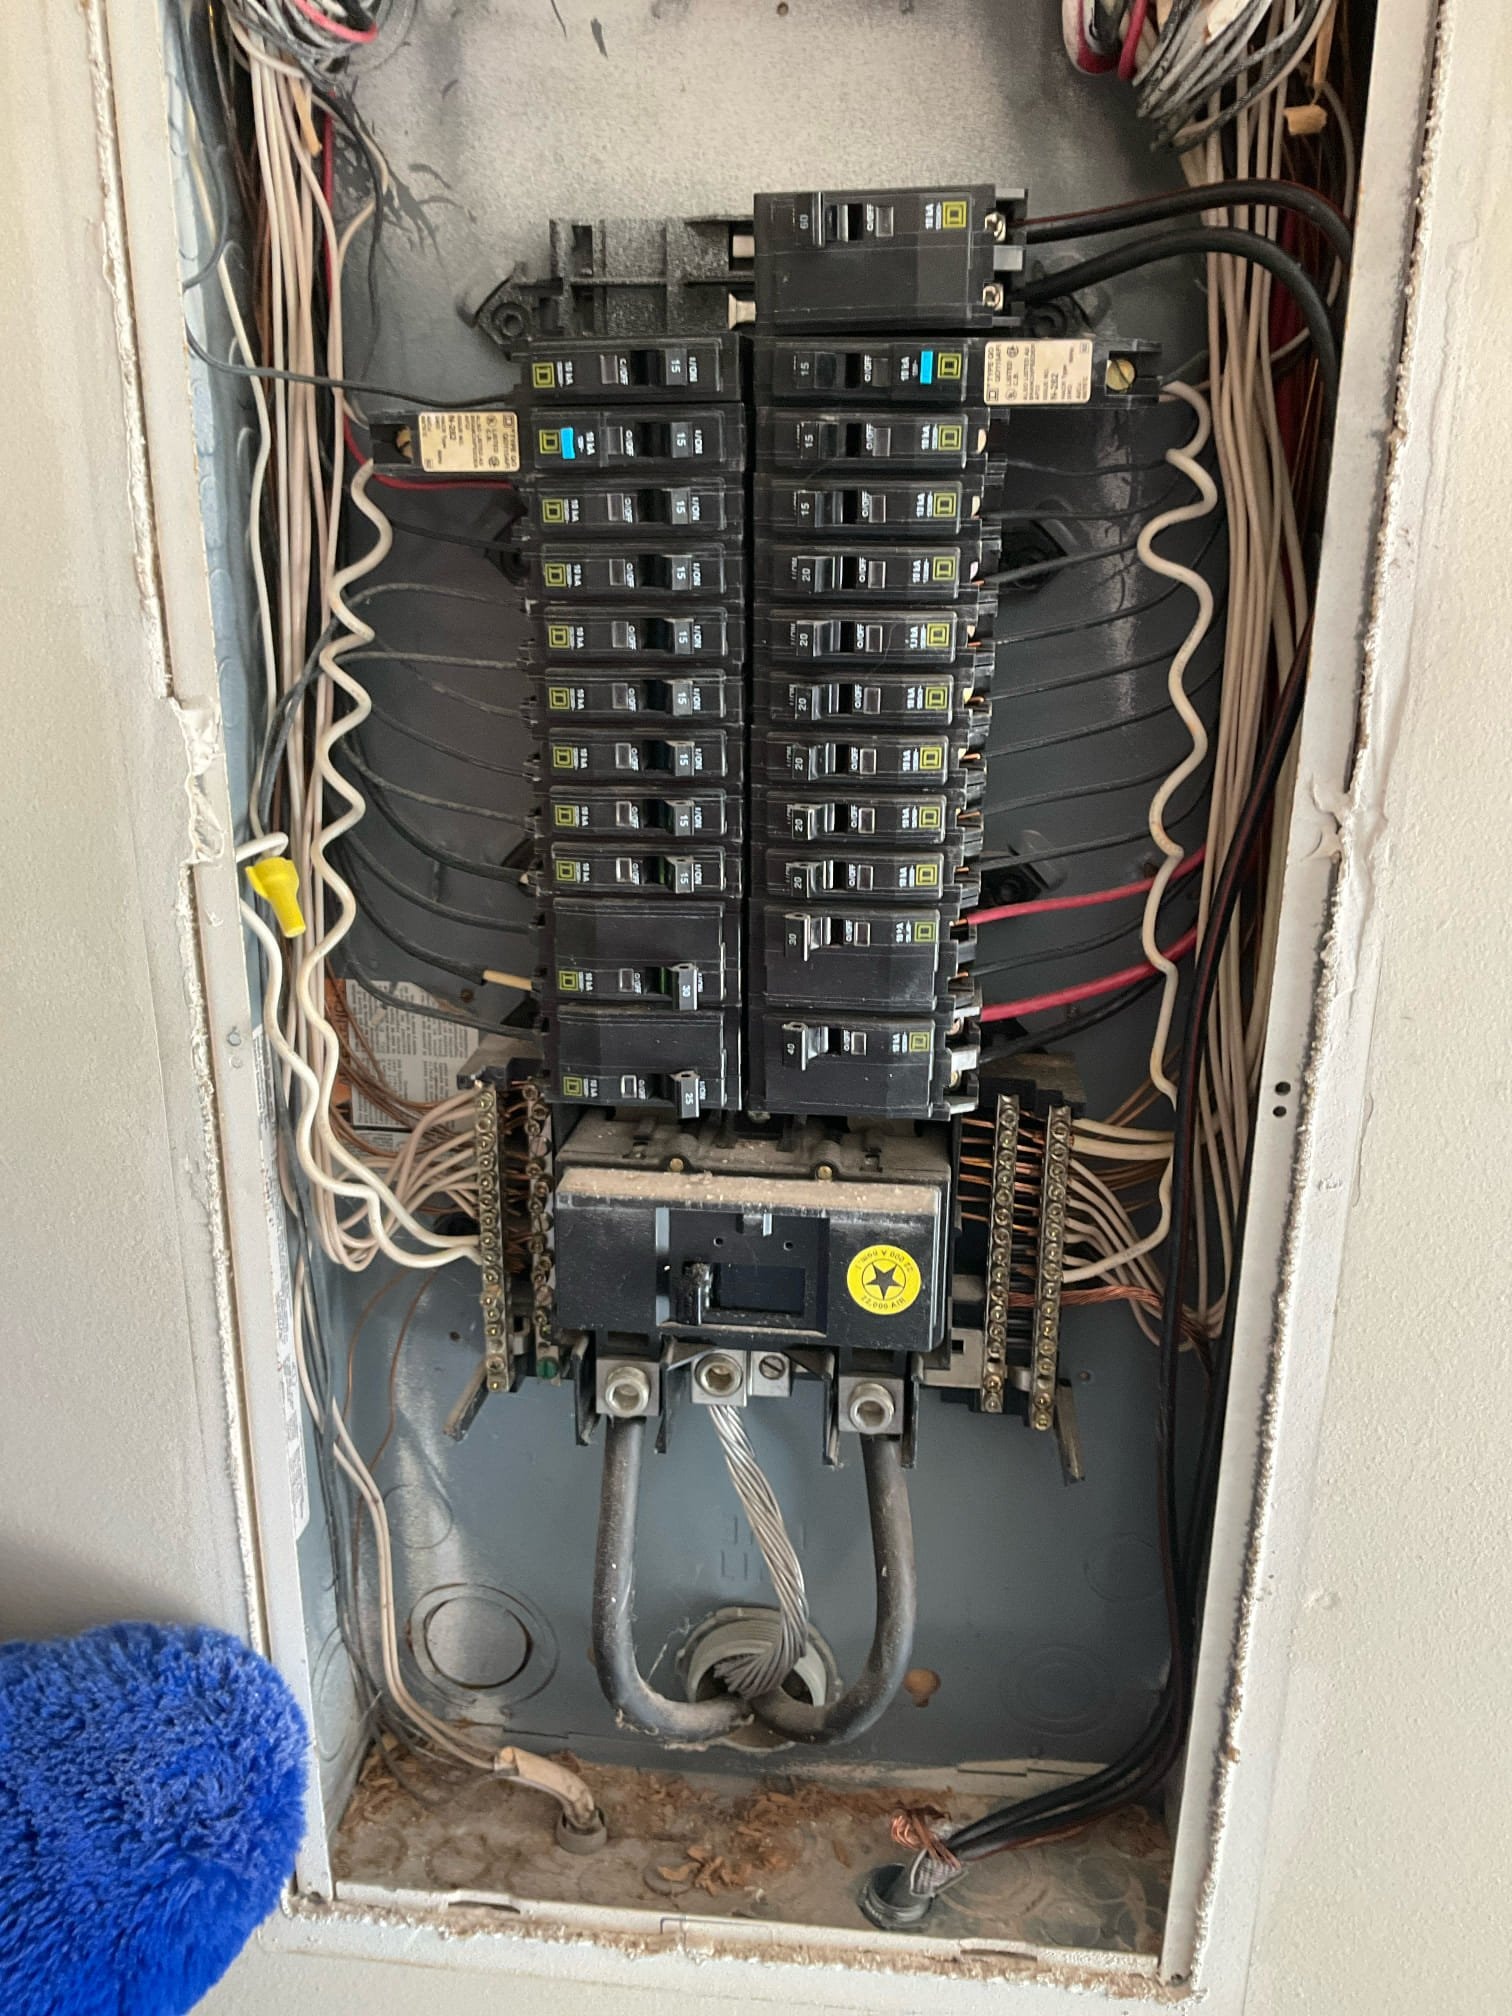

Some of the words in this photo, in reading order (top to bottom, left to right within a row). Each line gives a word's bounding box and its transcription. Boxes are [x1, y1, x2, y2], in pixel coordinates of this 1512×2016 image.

[671, 359, 681, 373] 15
[801, 362, 809, 376] 15
[676, 432, 686, 447] 15
[805, 434, 814, 448] 15
[675, 501, 686, 514] 15
[801, 502, 810, 516] 15
[676, 566, 686, 580] 15
[802, 568, 811, 582] 20
[678, 631, 688, 644] 15
[800, 633, 808, 647] 20
[677, 692, 687, 705] 15
[799, 697, 808, 711] 20
[679, 754, 689, 767] 15
[795, 757, 804, 771] 20
[679, 815, 689, 827] 15
[795, 818, 803, 831] 20
[680, 873, 689, 885] 15
[794, 876, 803, 889] 20
[789, 933, 798, 945] 30
[787, 1043, 795, 1055] 40
